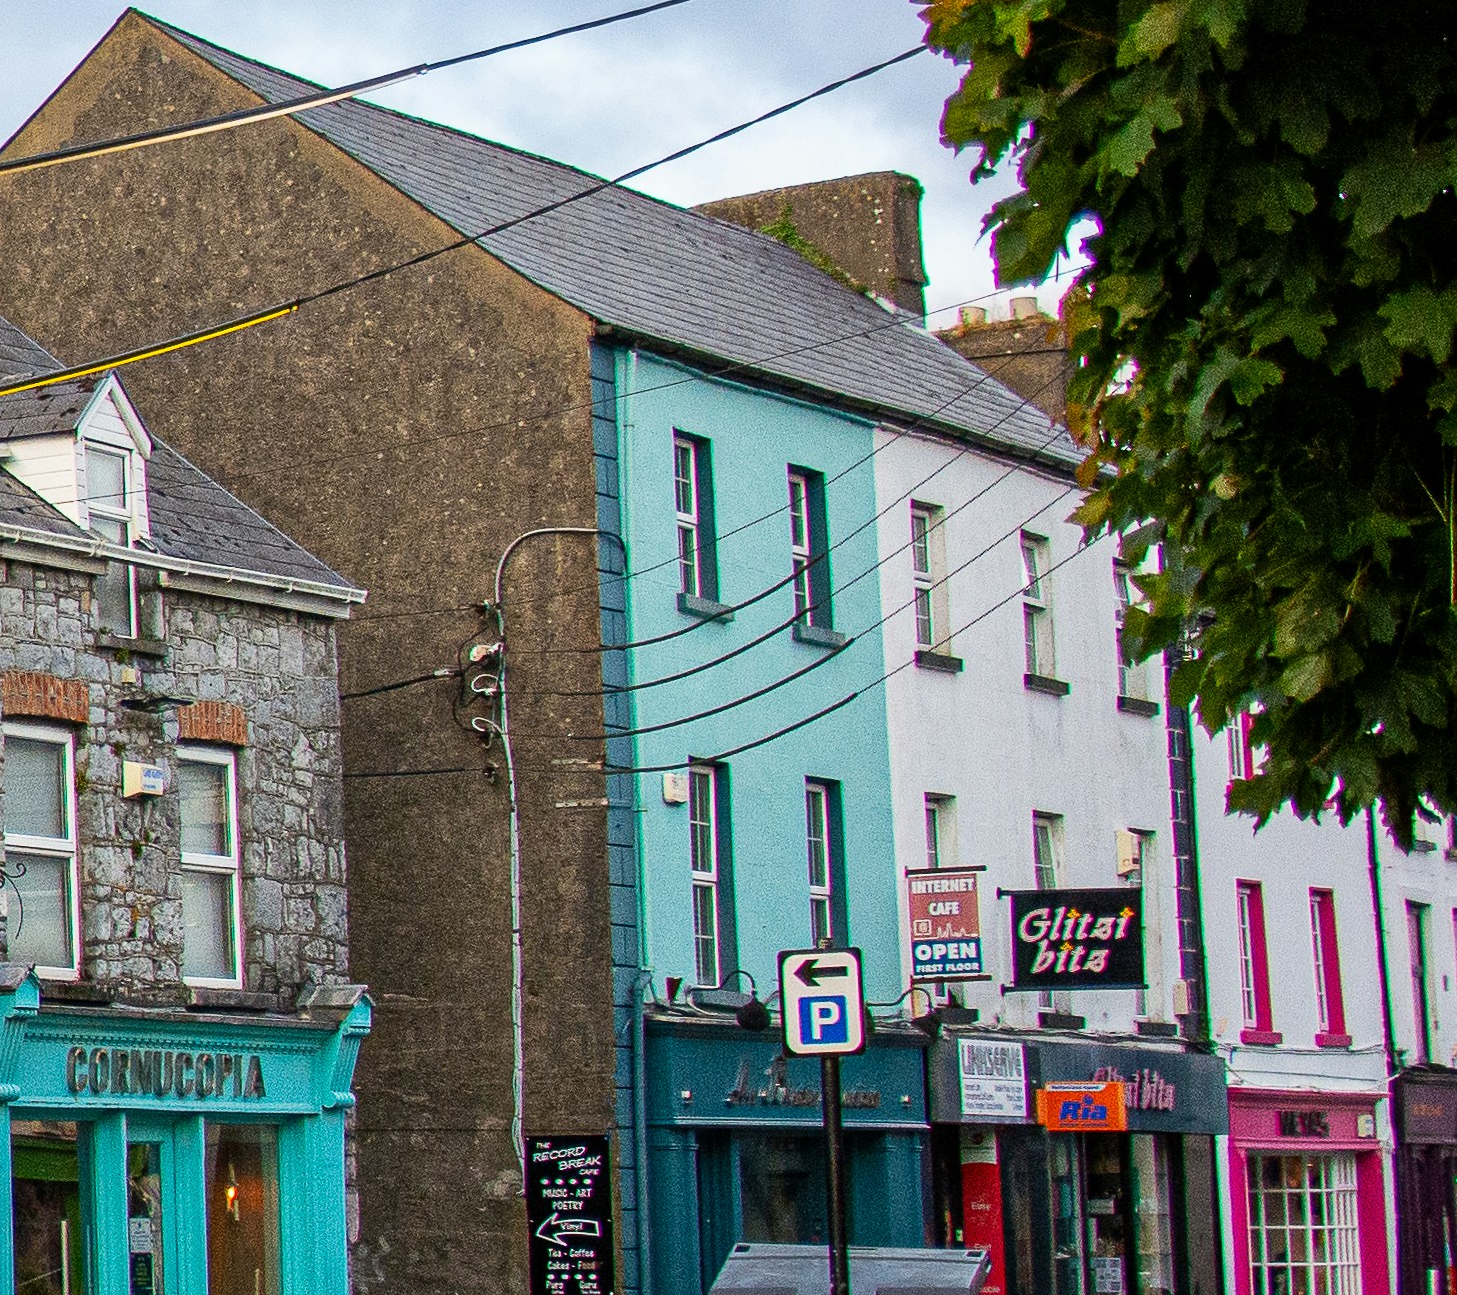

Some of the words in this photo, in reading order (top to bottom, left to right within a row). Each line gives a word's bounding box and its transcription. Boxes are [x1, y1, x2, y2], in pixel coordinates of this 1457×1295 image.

[911, 878, 974, 895] INTERNET
[929, 901, 960, 916] CAFE
[1018, 906, 1134, 943] Glitzi
[915, 943, 977, 961] OPEN
[1030, 939, 1110, 974] bitz
[946, 962, 980, 972] FLOOR
[810, 999, 841, 1040] P
[66, 1045, 266, 1099] CORNUCOPIA
[1060, 1094, 1107, 1120] Ria
[533, 1146, 586, 1162] RECORD
[558, 1155, 602, 1171] BREAK
[576, 1187, 592, 1198] ART
[552, 1200, 584, 1210] POETRY
